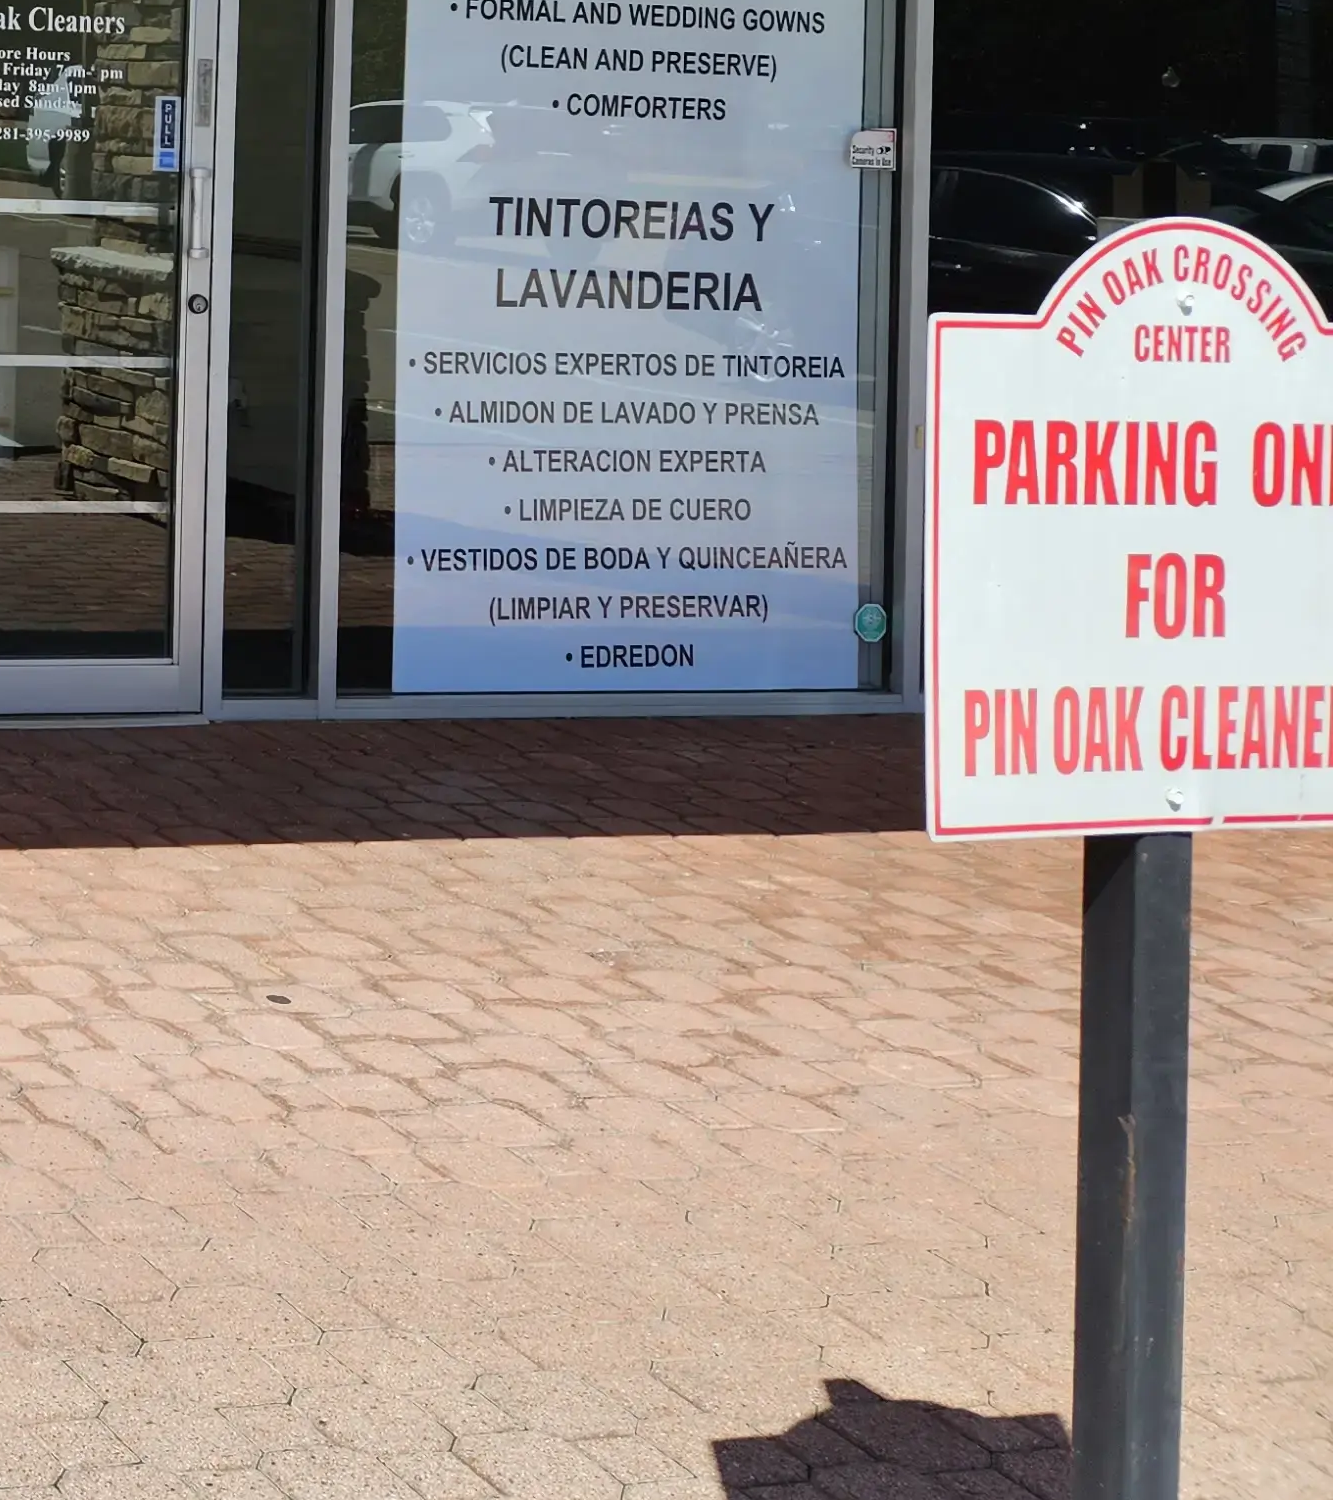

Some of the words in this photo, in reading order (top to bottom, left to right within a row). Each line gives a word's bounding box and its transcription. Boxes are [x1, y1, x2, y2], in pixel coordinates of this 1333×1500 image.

[28, 6, 125, 34] Cleaners
[573, 1, 621, 25] AND
[629, 4, 735, 31] WEDDING
[743, 9, 825, 34] GOWNS
[3, 62, 51, 79] Friday
[26, 47, 70, 62] Hours
[500, 45, 587, 73] (CLEAN
[595, 48, 644, 72] AND
[651, 50, 777, 82] PRESERVE)
[567, 93, 726, 121] COMFORTERS
[164, 103, 172, 145] PULL
[489, 196, 735, 241] TINTOREIAS
[748, 203, 774, 242] Y
[495, 268, 762, 311] LAVANDERIA
[1055, 292, 1108, 359] PIN
[1102, 247, 1162, 306] OAK
[1173, 245, 1307, 363] CROSSING
[1134, 325, 1231, 364] CENTER
[423, 352, 547, 376] SERVICIOS
[555, 353, 677, 376] EXPERTOS
[685, 355, 715, 377] DE
[722, 355, 845, 379] TINTOREIA
[449, 401, 556, 425] ALMIDON
[563, 402, 594, 424] DE
[601, 402, 696, 425] LAVADO
[703, 403, 718, 425] Y
[725, 403, 819, 426] PRENSA
[503, 449, 651, 473] ALTERACION
[659, 451, 766, 473] EXPERTA
[973, 419, 1218, 506] PARKING
[1252, 422, 1333, 507] ON
[519, 499, 625, 521] LIMPIEZA
[632, 499, 662, 521] DE
[669, 499, 751, 522] CUERO
[421, 548, 538, 572] VESTIDOS
[546, 548, 576, 571] DE
[584, 547, 651, 570] BODA
[657, 547, 673, 569] Y
[678, 541, 848, 571] QUINCEAÑERA
[489, 596, 591, 626] (LIMPIAR
[598, 596, 613, 619] Y
[620, 594, 769, 624] PRESERVAR)
[1125, 553, 1226, 639] FOR
[581, 644, 695, 668] EDREDON
[964, 688, 1038, 778] PIN
[1053, 686, 1144, 775] OAK
[1159, 684, 1333, 771] CLEANE
